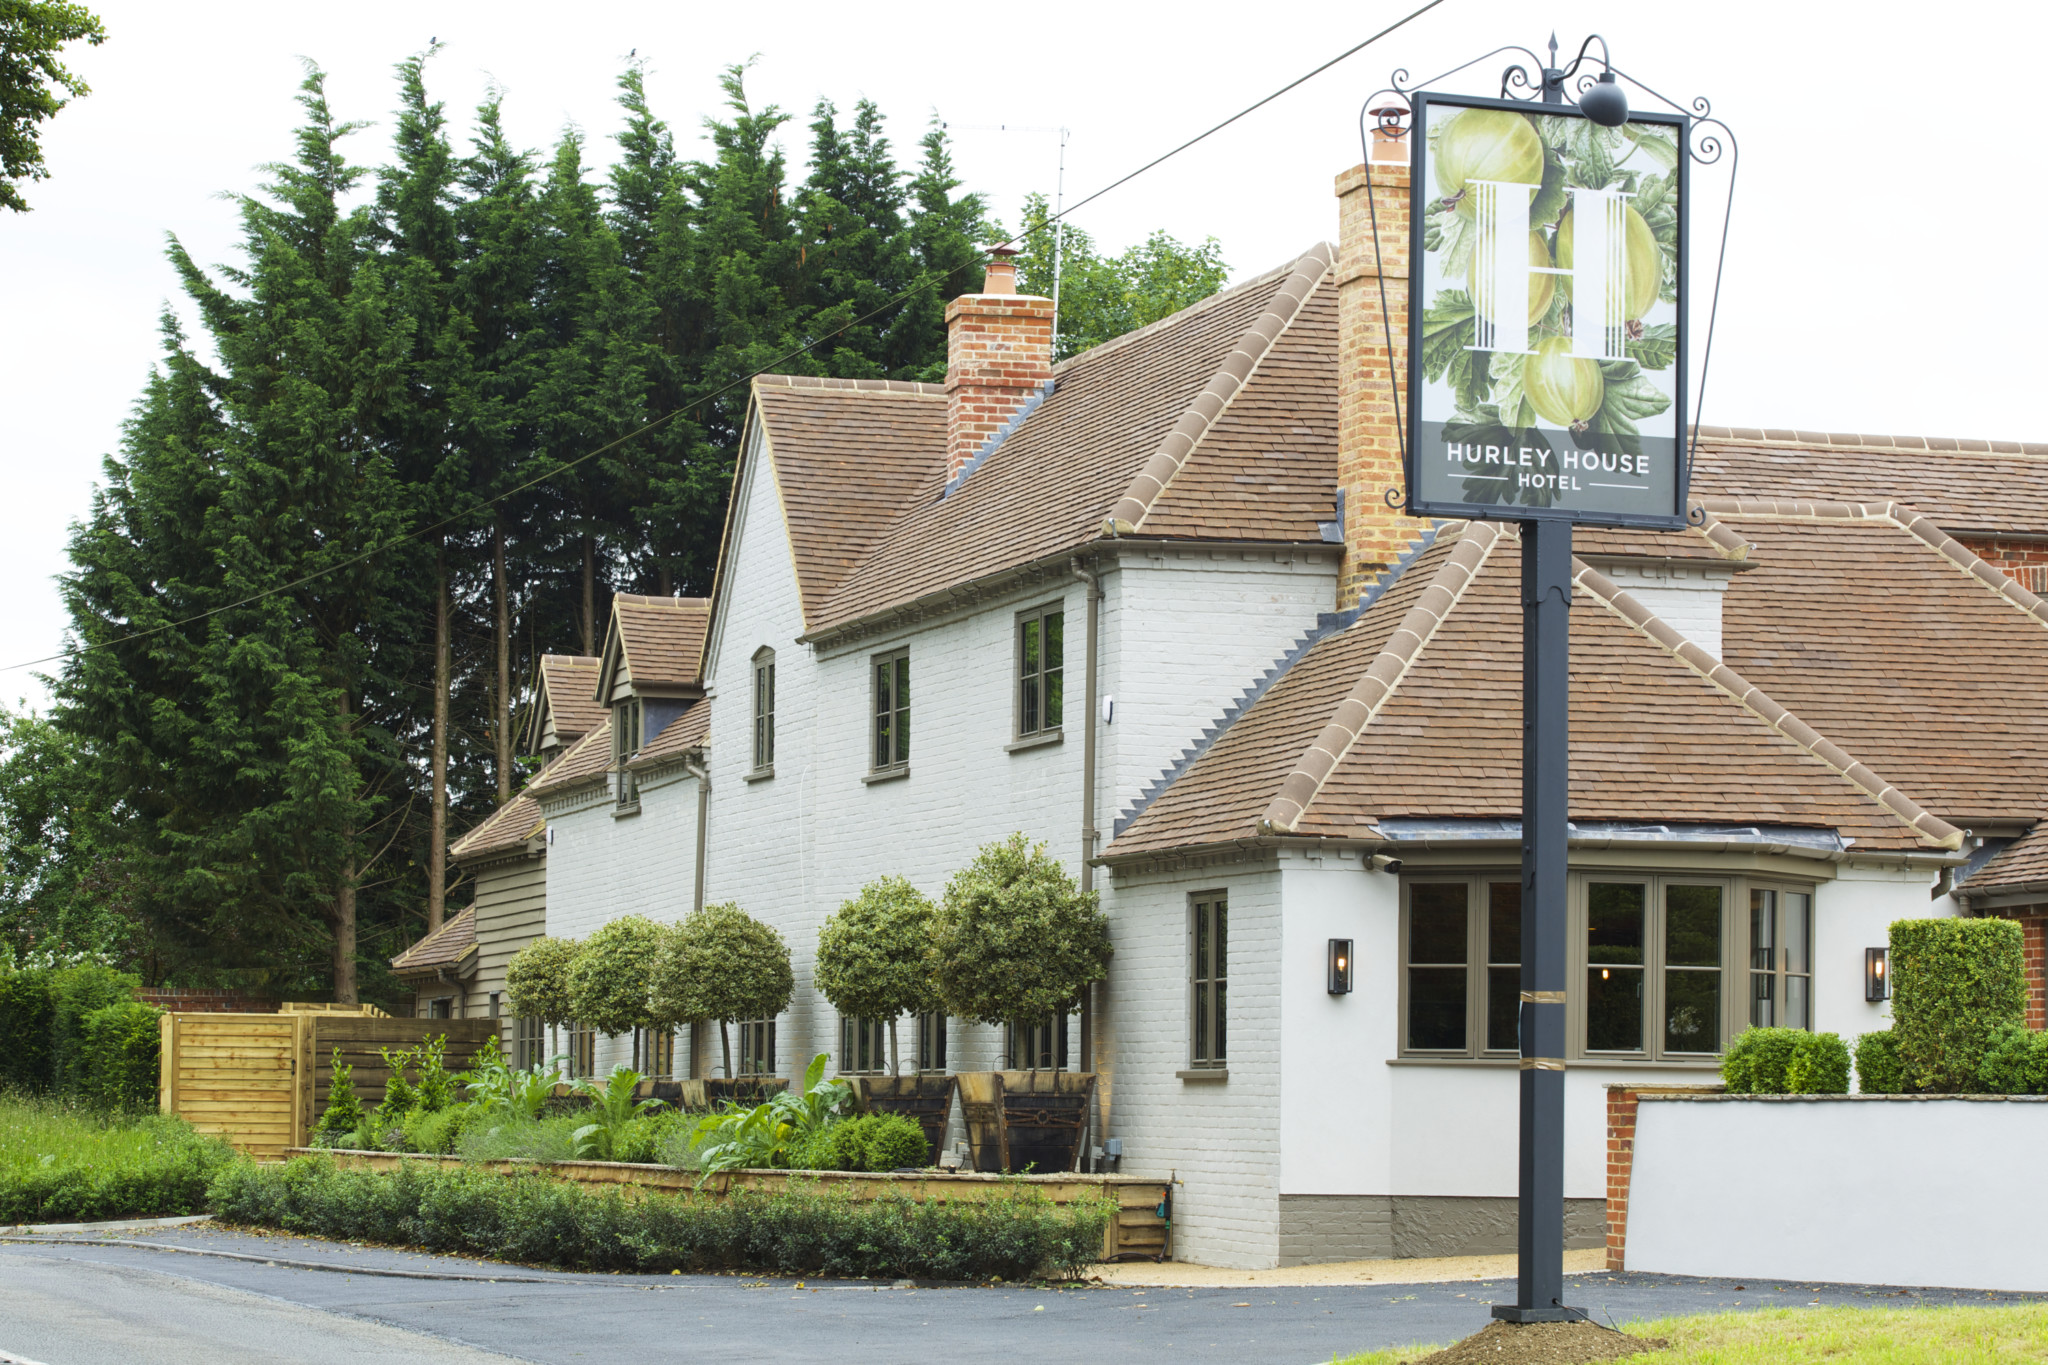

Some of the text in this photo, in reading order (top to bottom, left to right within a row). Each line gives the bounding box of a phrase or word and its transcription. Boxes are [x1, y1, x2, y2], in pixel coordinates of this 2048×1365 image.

[1463, 179, 1637, 361] H
[1447, 443, 1650, 474] HURLEY HOUSE
[1518, 473, 1581, 490] HOTEL
